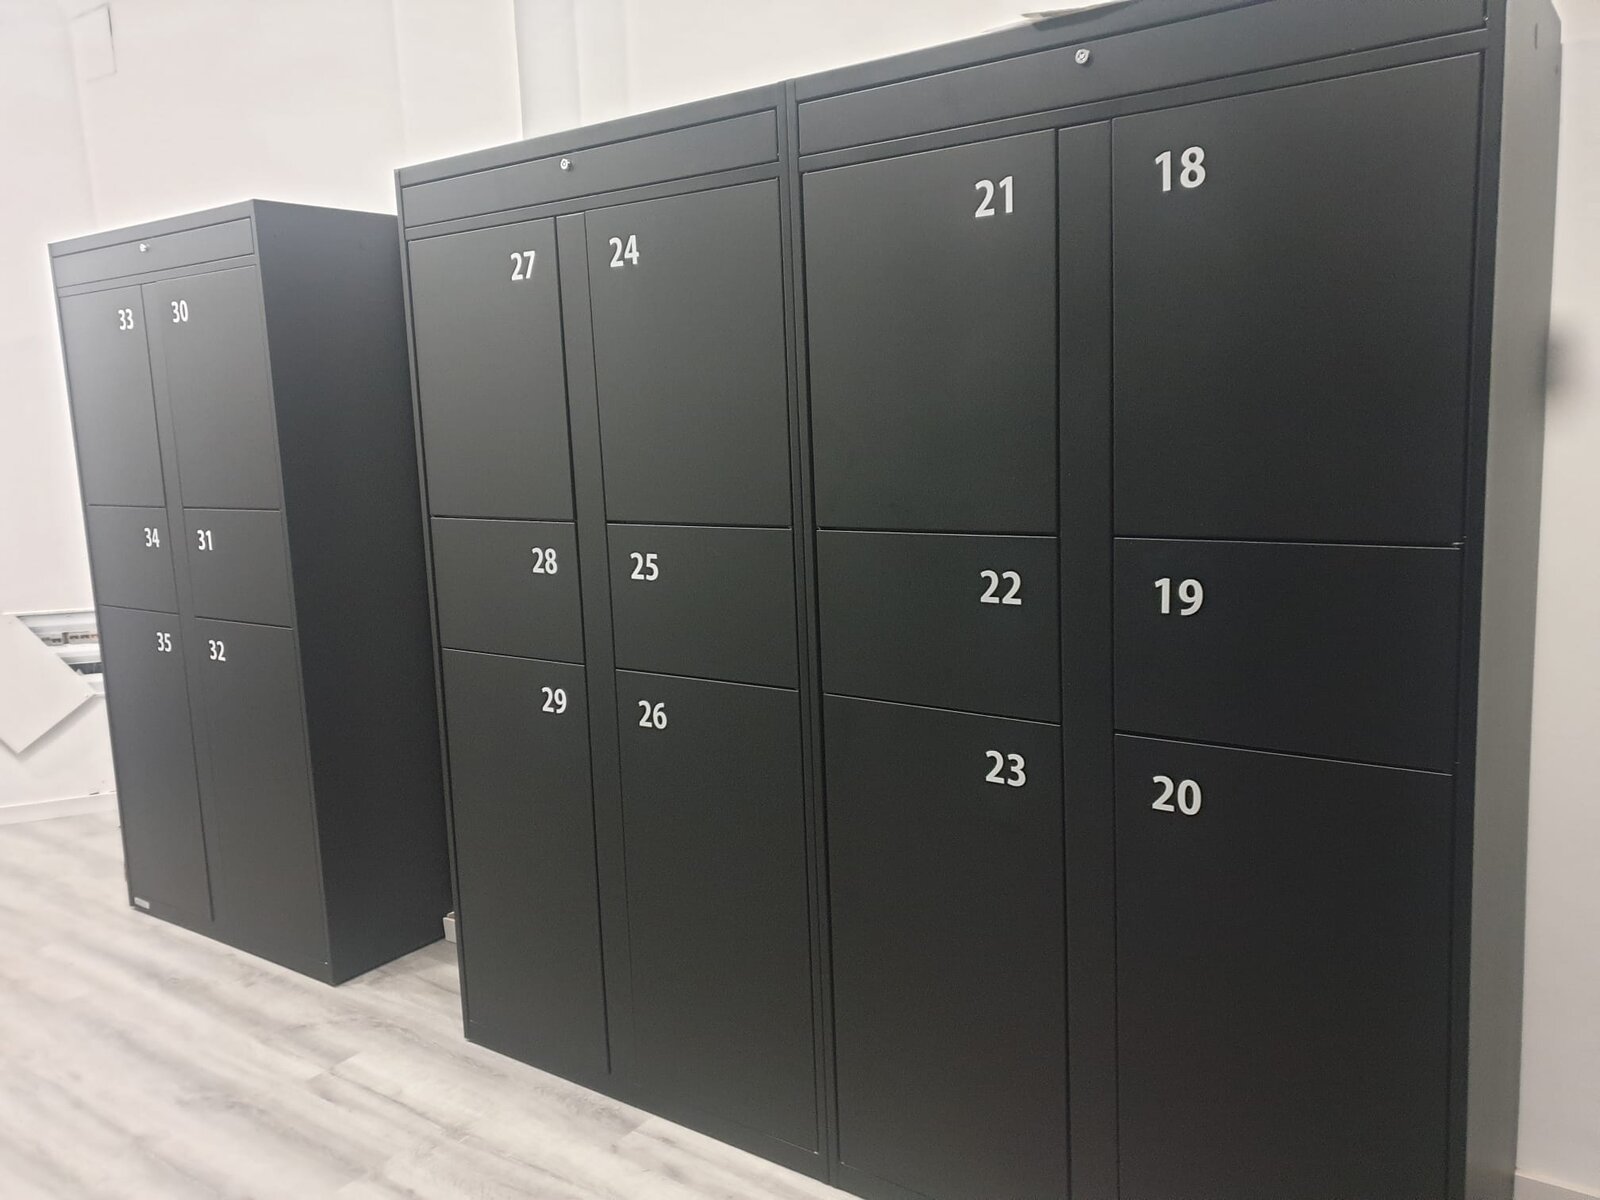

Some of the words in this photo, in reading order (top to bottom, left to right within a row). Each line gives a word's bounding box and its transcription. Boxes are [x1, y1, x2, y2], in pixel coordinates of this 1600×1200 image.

[1154, 146, 1206, 192] 18
[974, 175, 1013, 218] 21
[510, 250, 536, 281] 27
[609, 234, 640, 268] 24
[118, 308, 134, 331] 33
[171, 299, 189, 323] 30
[144, 527, 160, 548] 34
[197, 529, 213, 551] 31
[531, 547, 558, 575] 28
[630, 552, 659, 581] 25
[980, 569, 1022, 605] 22
[1154, 577, 1203, 616] 19
[156, 631, 172, 653] 35
[208, 639, 226, 662] 32
[541, 686, 567, 714] 29
[638, 700, 668, 730] 26
[985, 750, 1026, 787] 23
[1151, 775, 1202, 816] 20
